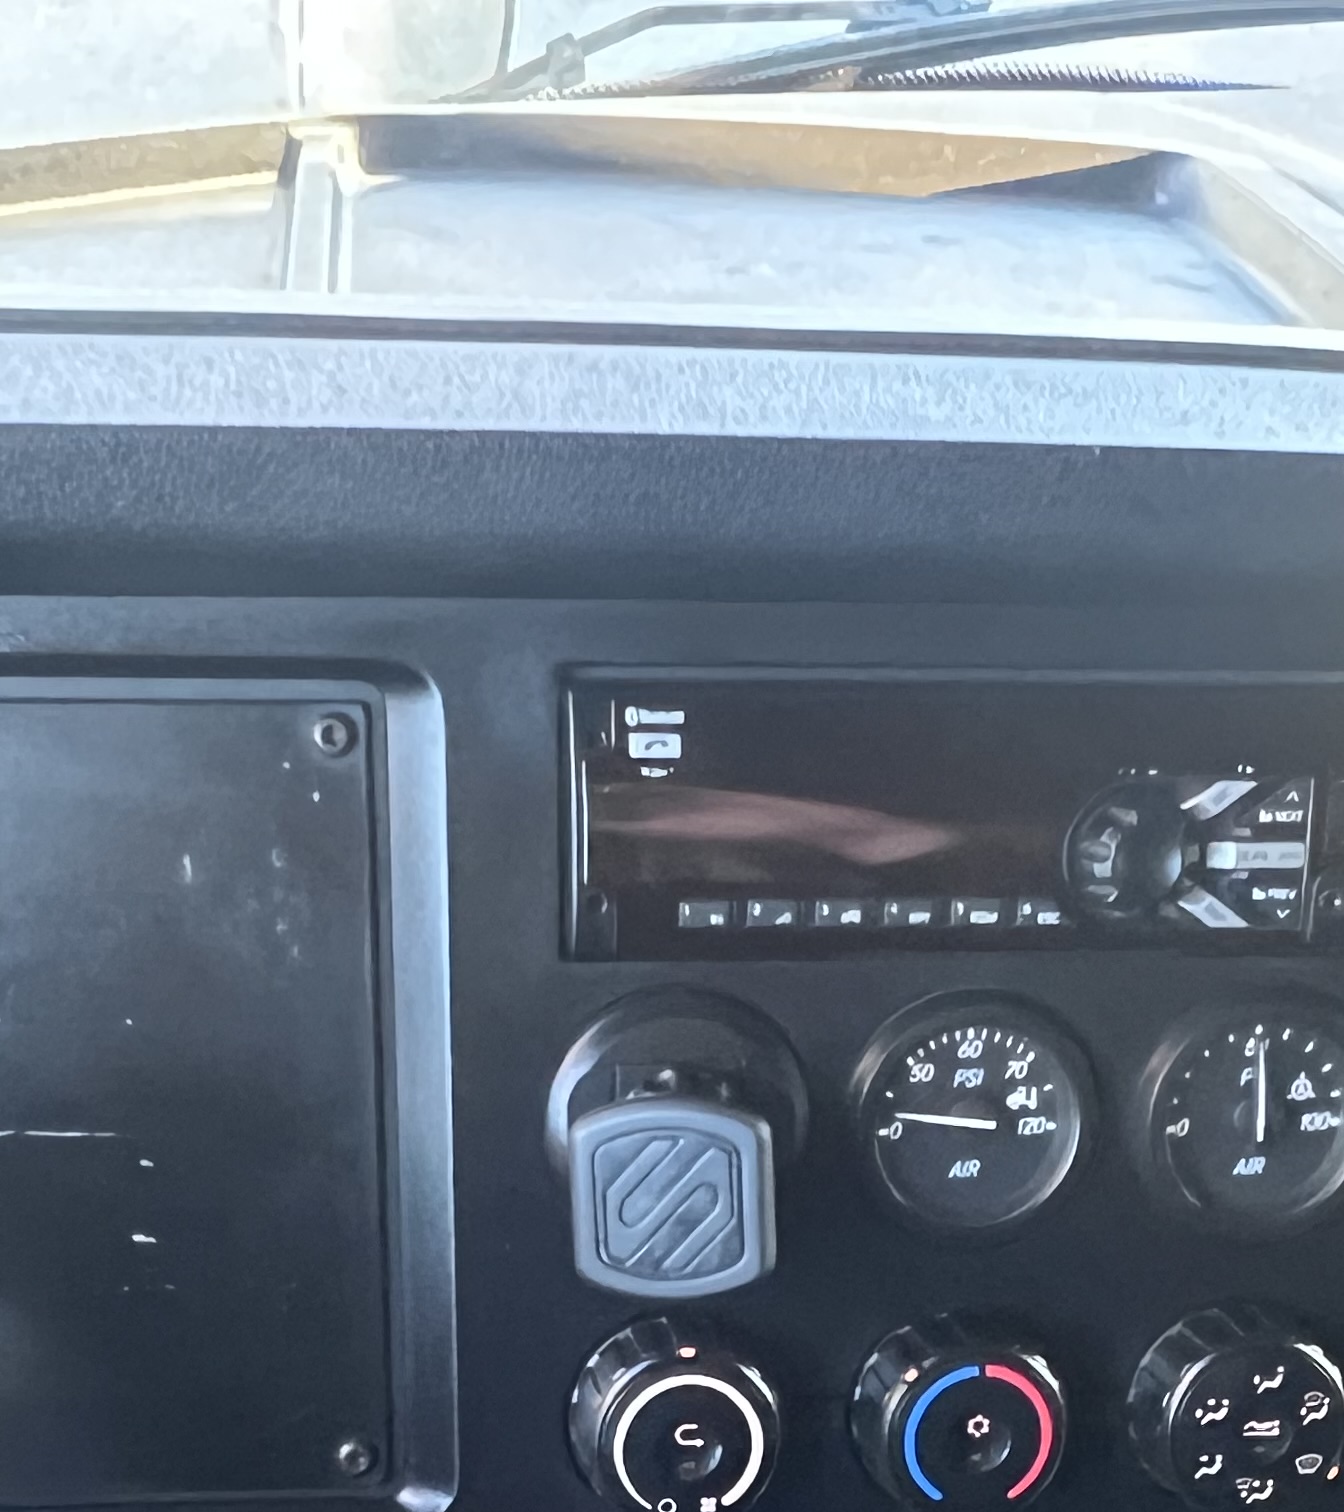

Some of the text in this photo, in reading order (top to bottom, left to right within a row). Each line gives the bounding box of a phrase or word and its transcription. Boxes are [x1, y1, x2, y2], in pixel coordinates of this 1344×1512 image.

[957, 1039, 983, 1060] 60
[909, 1063, 935, 1083] 50
[953, 1068, 984, 1088] PSI
[1004, 1060, 1029, 1080] 70
[888, 1121, 903, 1140] 0
[1176, 1117, 1190, 1137] 0
[947, 1159, 981, 1178] AIR
[1231, 1156, 1266, 1175] AIR
